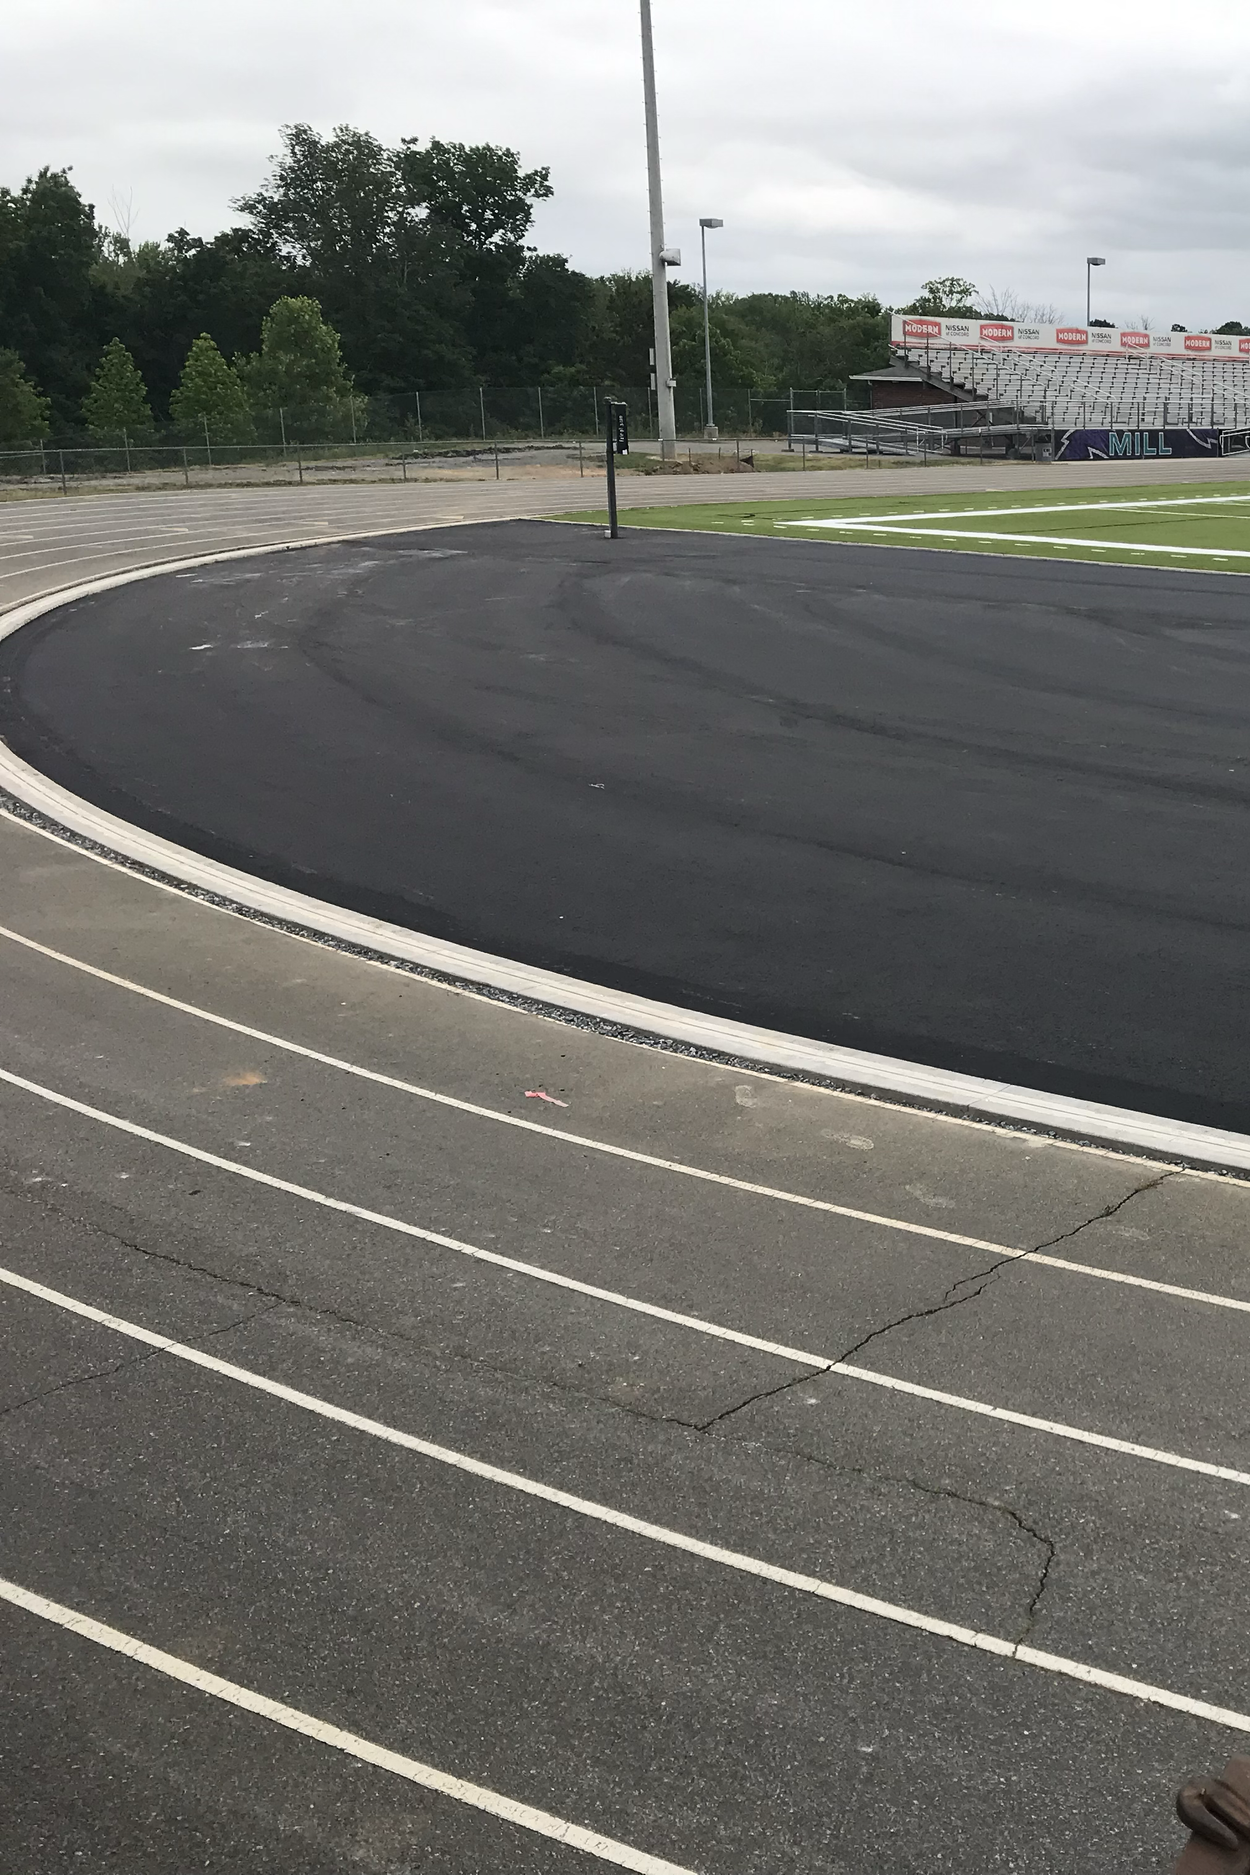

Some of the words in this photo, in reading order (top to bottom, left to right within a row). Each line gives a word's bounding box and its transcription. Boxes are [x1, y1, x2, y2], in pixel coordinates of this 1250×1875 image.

[905, 323, 939, 334] MODERN
[945, 324, 970, 332] NISSAN
[982, 328, 1012, 337] MODERN
[1058, 332, 1087, 341] MODERN
[1122, 335, 1148, 344] MODERN
[1185, 339, 1210, 348] MODERN
[1109, 432, 1172, 456] MILL
